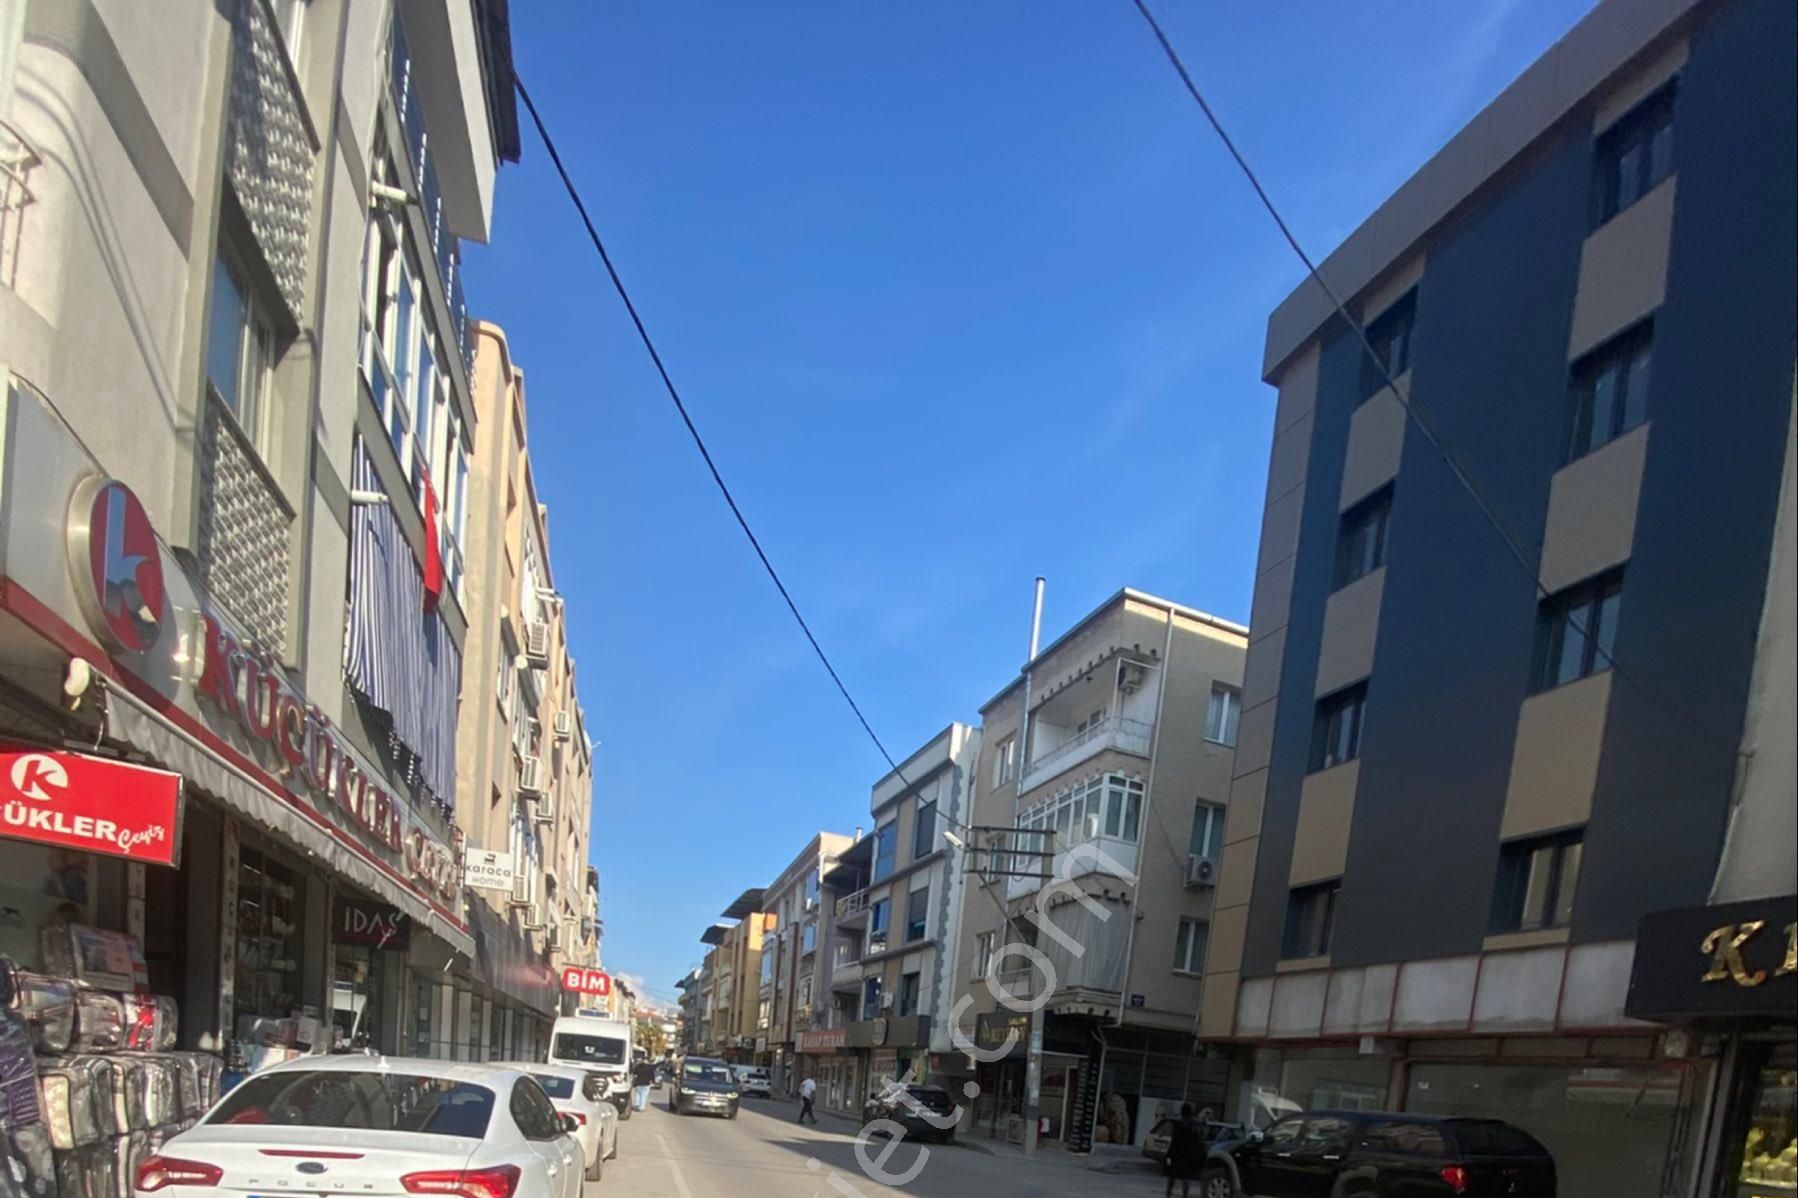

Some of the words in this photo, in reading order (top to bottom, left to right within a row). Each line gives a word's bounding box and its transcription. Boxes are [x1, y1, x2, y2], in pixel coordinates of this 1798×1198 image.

[191, 612, 403, 856] KÜÇÜKLER
[0, 800, 118, 842] ÜKLER
[466, 864, 512, 878] karaca
[567, 970, 606, 992] BİM
